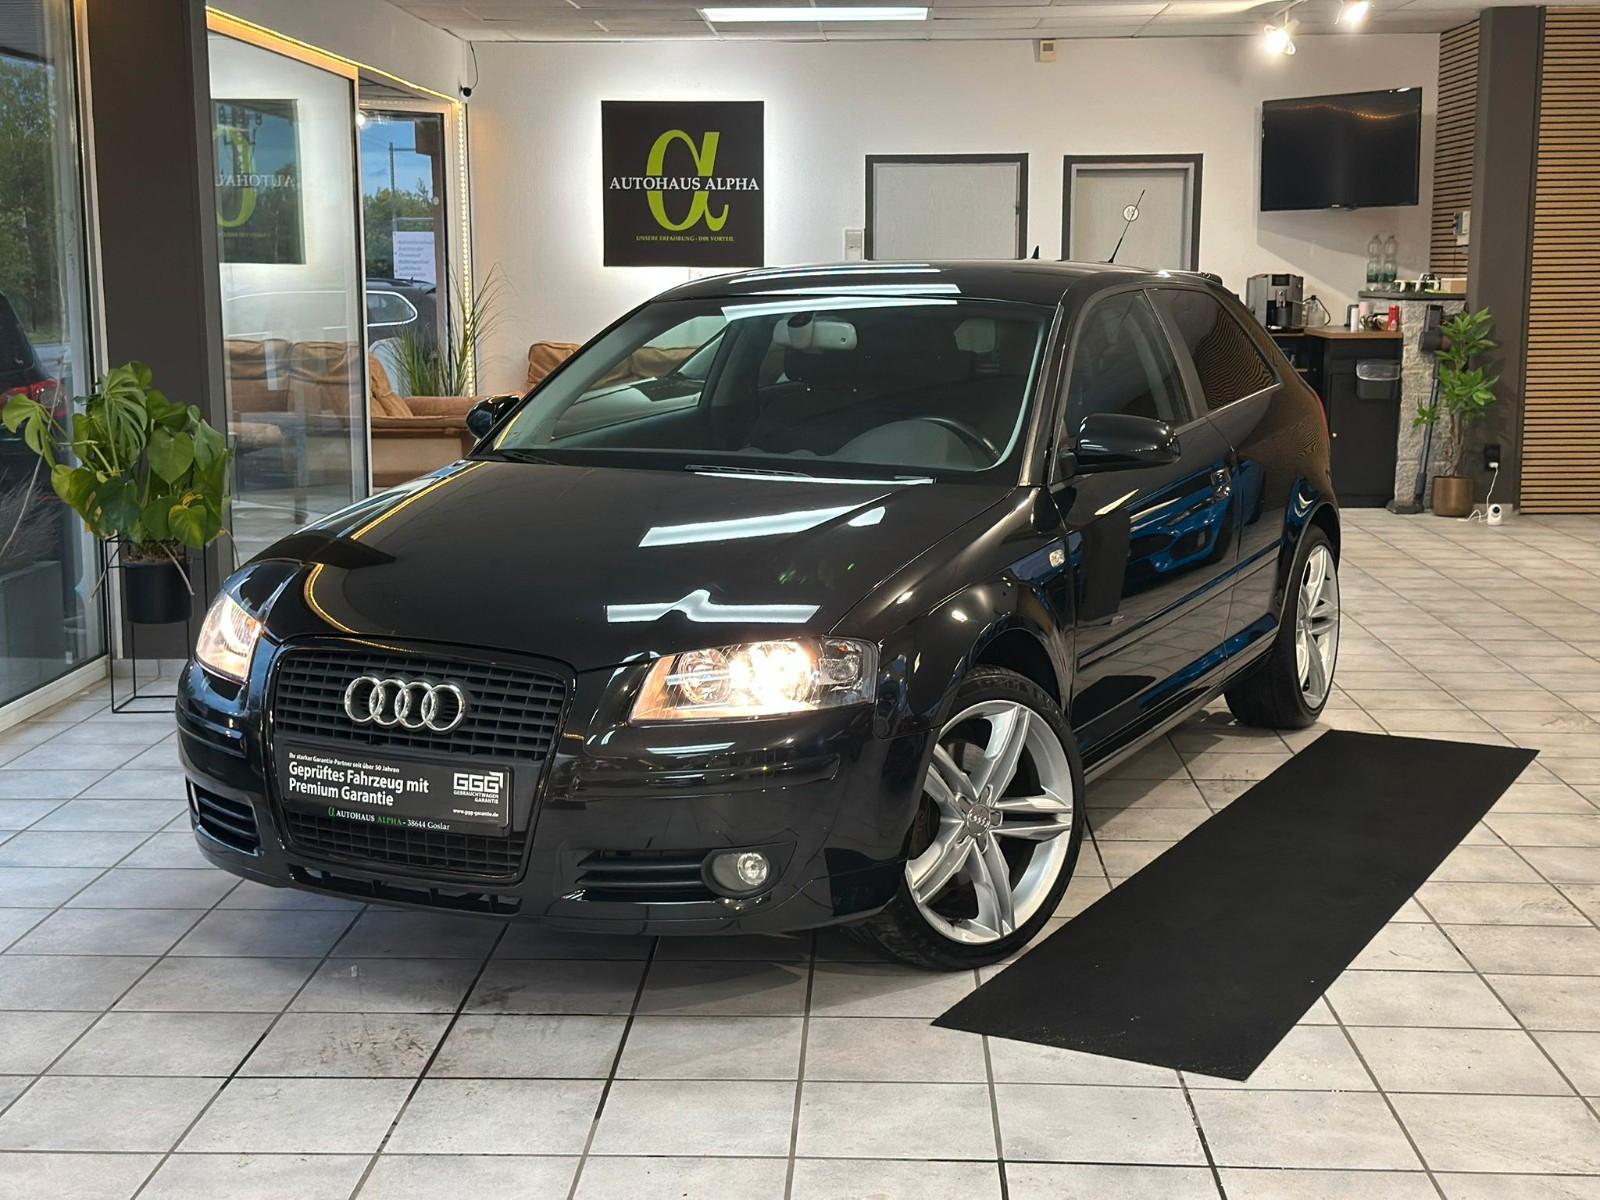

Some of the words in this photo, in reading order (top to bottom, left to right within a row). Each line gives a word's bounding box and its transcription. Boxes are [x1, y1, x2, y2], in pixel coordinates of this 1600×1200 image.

[609, 176, 701, 191] AUTOHAUS
[704, 177, 760, 191] ALPHA
[296, 753, 313, 761] starker
[313, 756, 353, 767] Garantie-Partner
[353, 761, 362, 769] seit
[362, 762, 374, 770] über
[382, 765, 400, 773] Jahren
[289, 761, 345, 782] Geprüftes
[347, 769, 404, 794] Fahrzeug
[406, 777, 430, 794] mit
[453, 772, 500, 794] GGG
[289, 777, 339, 799] Premium
[341, 785, 394, 806] Garantie
[453, 790, 499, 799] GEBRAUCHTWAGEN
[474, 797, 499, 805] GARANTIE
[336, 810, 375, 822] AUTOHAUS
[377, 816, 402, 826] ALPHA
[407, 819, 426, 829] 38644
[427, 820, 451, 831] Goslar
